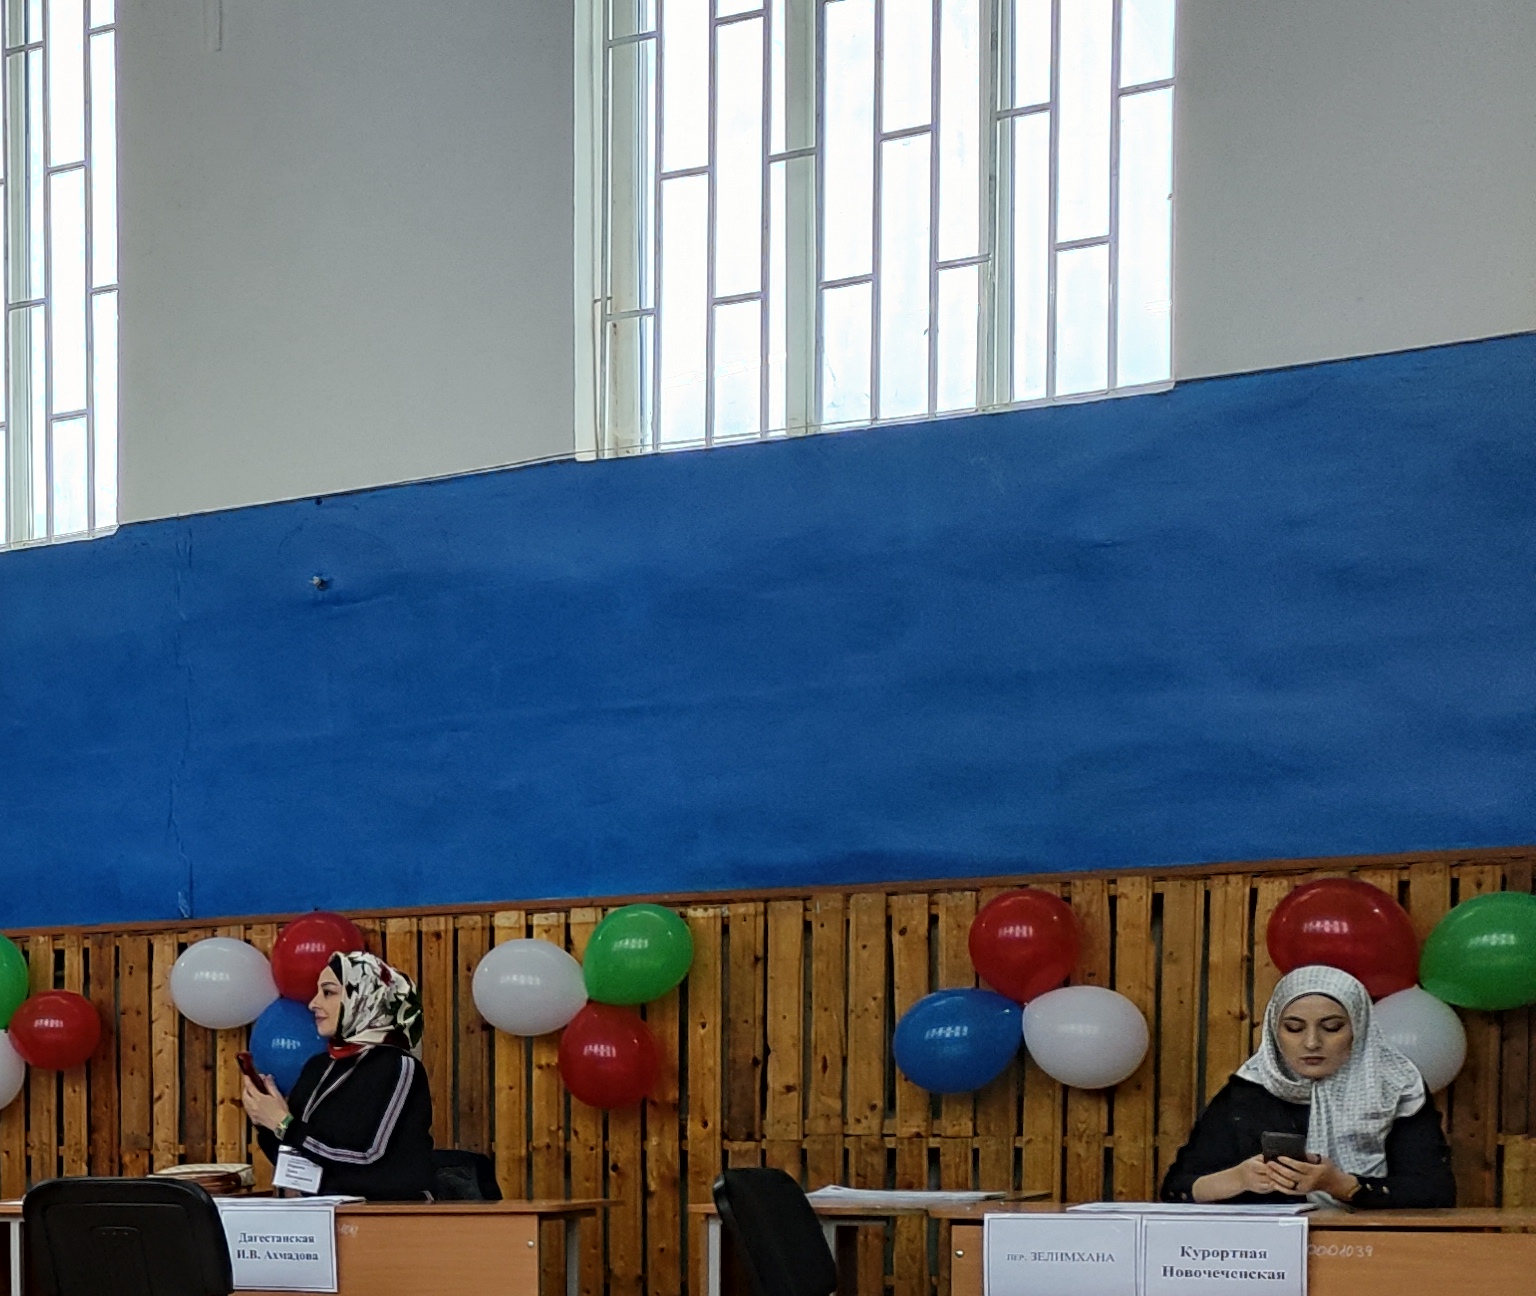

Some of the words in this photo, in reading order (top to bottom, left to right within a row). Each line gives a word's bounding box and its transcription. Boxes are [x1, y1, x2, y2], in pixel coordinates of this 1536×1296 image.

[238, 1232, 315, 1244] Дагестанская
[263, 1250, 319, 1261] Ахмадова
[1030, 1251, 1115, 1263] ЗЕЛИМХАНА
[1179, 1245, 1268, 1262] Курортная
[1161, 1265, 1286, 1281] Новочеченская
